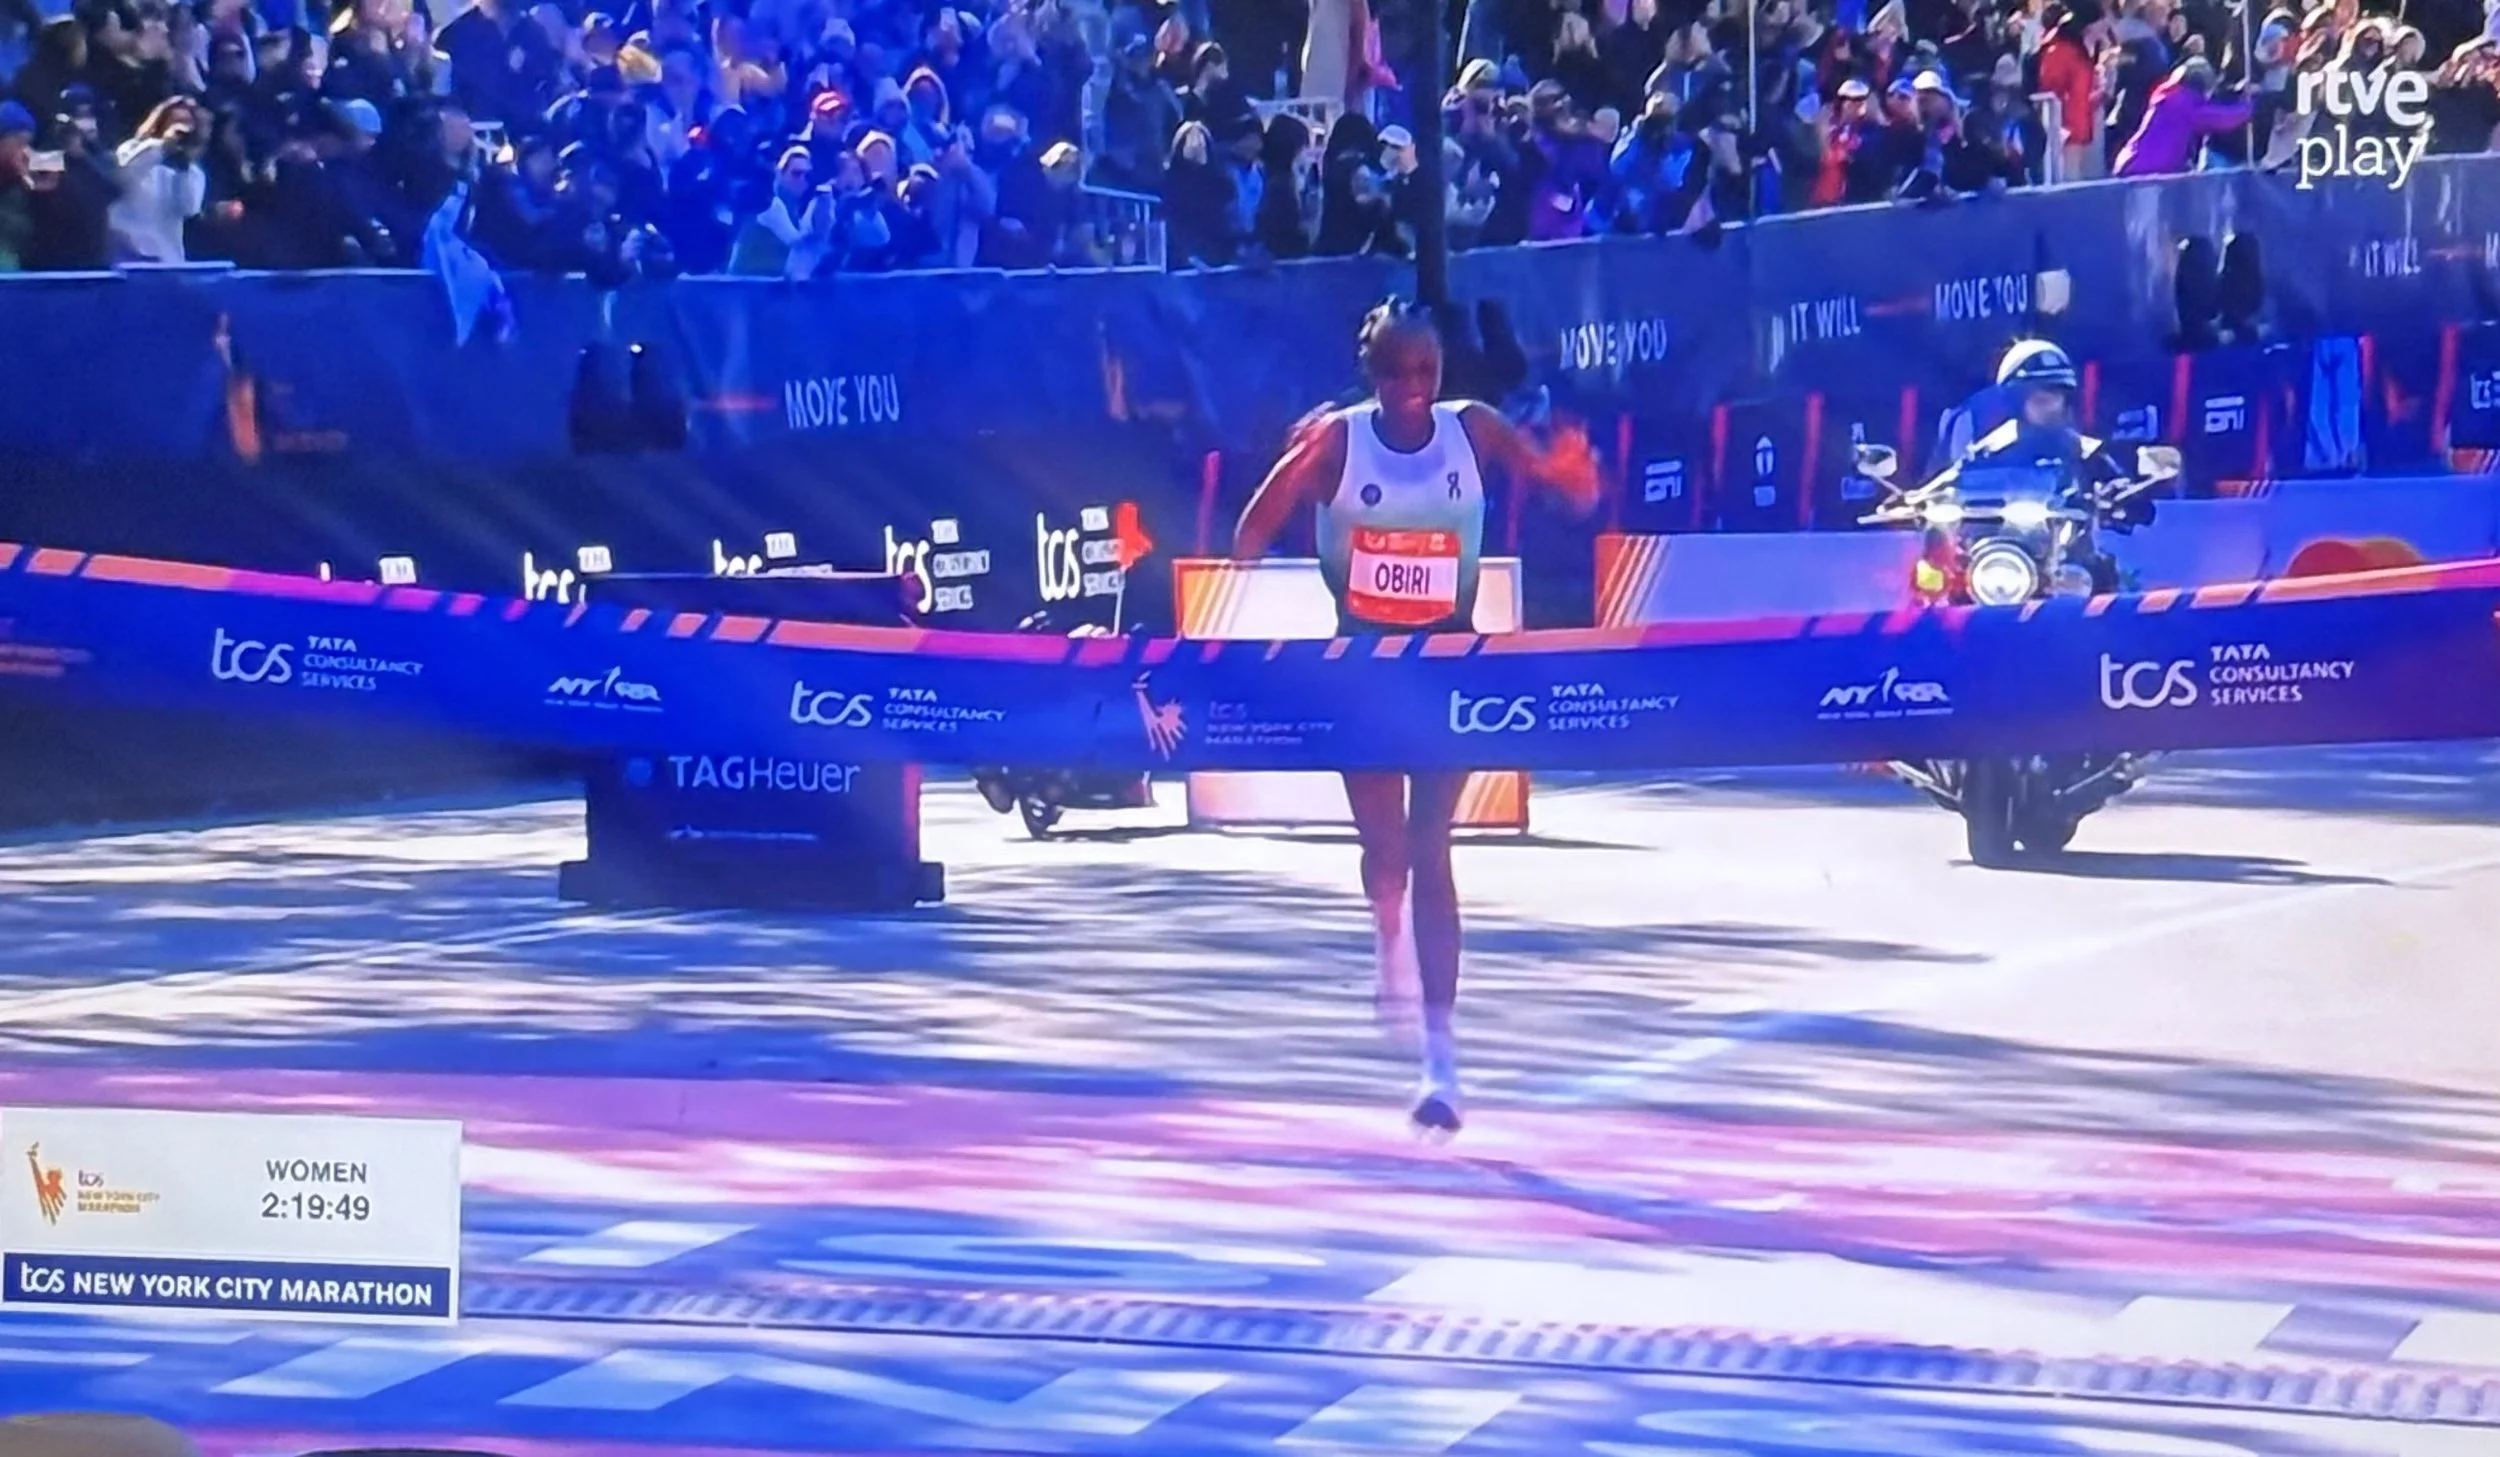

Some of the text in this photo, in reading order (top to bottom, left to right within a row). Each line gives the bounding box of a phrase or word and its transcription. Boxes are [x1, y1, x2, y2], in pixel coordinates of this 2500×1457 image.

[1935, 273, 2028, 320] MOVE YOU
[1790, 295, 1861, 344] IT WILL
[1559, 318, 1668, 370] MOVE YOU
[785, 373, 900, 429] MOVE YOU
[1037, 511, 1080, 602] tcs
[1375, 563, 1431, 595] OBIRI
[211, 626, 296, 685] tcs
[2209, 660, 2355, 684] CONSULTANCY
[2210, 643, 2271, 662] TATA
[887, 687, 938, 702] TATA
[1551, 683, 1605, 697] TATA
[2101, 653, 2198, 710] tcs
[2210, 684, 2303, 706] SERVICES
[790, 679, 873, 728] tcs
[1449, 690, 1537, 733] tcs
[1547, 712, 1630, 730] SERVICES
[1548, 695, 1680, 715] CONSULTANCY
